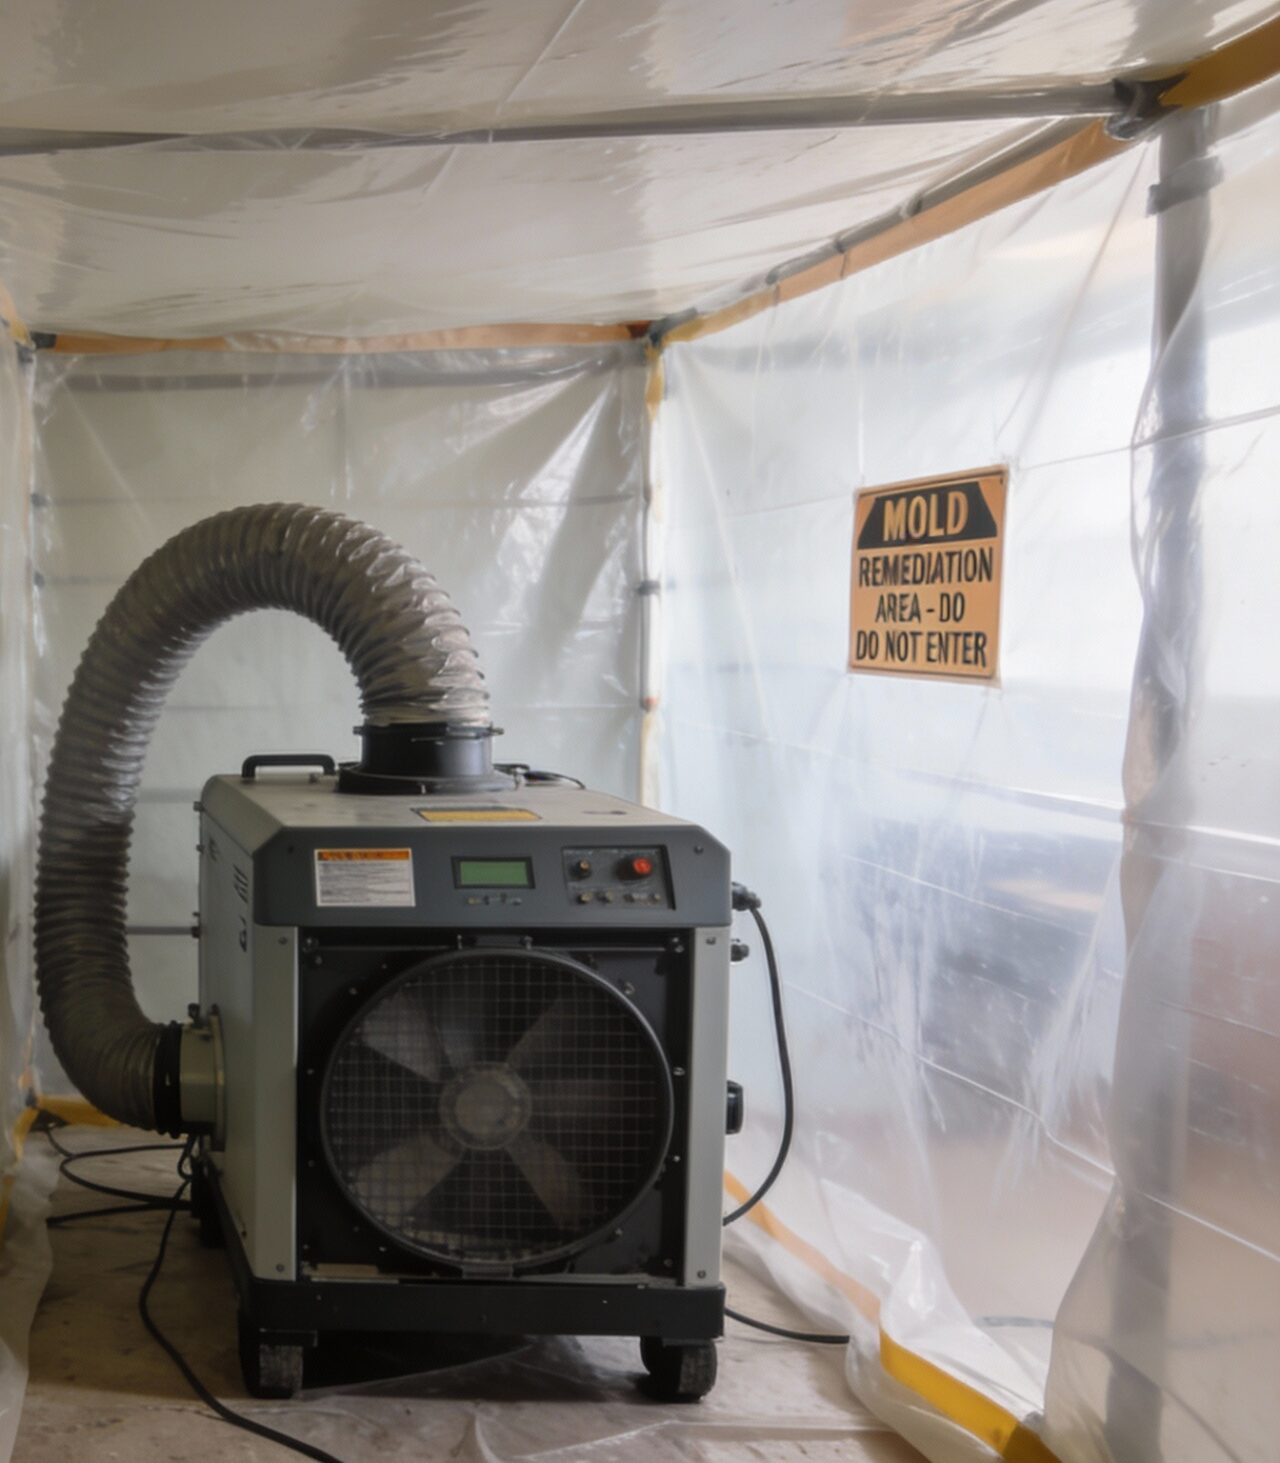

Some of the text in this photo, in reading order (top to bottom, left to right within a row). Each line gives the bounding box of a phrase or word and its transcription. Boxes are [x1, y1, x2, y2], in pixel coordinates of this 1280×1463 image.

[883, 491, 968, 541] MOLD
[858, 547, 993, 588] REMEDIATION
[875, 592, 921, 623] AREA
[939, 592, 965, 622] DO
[856, 630, 987, 668] DO NOT ENTER
